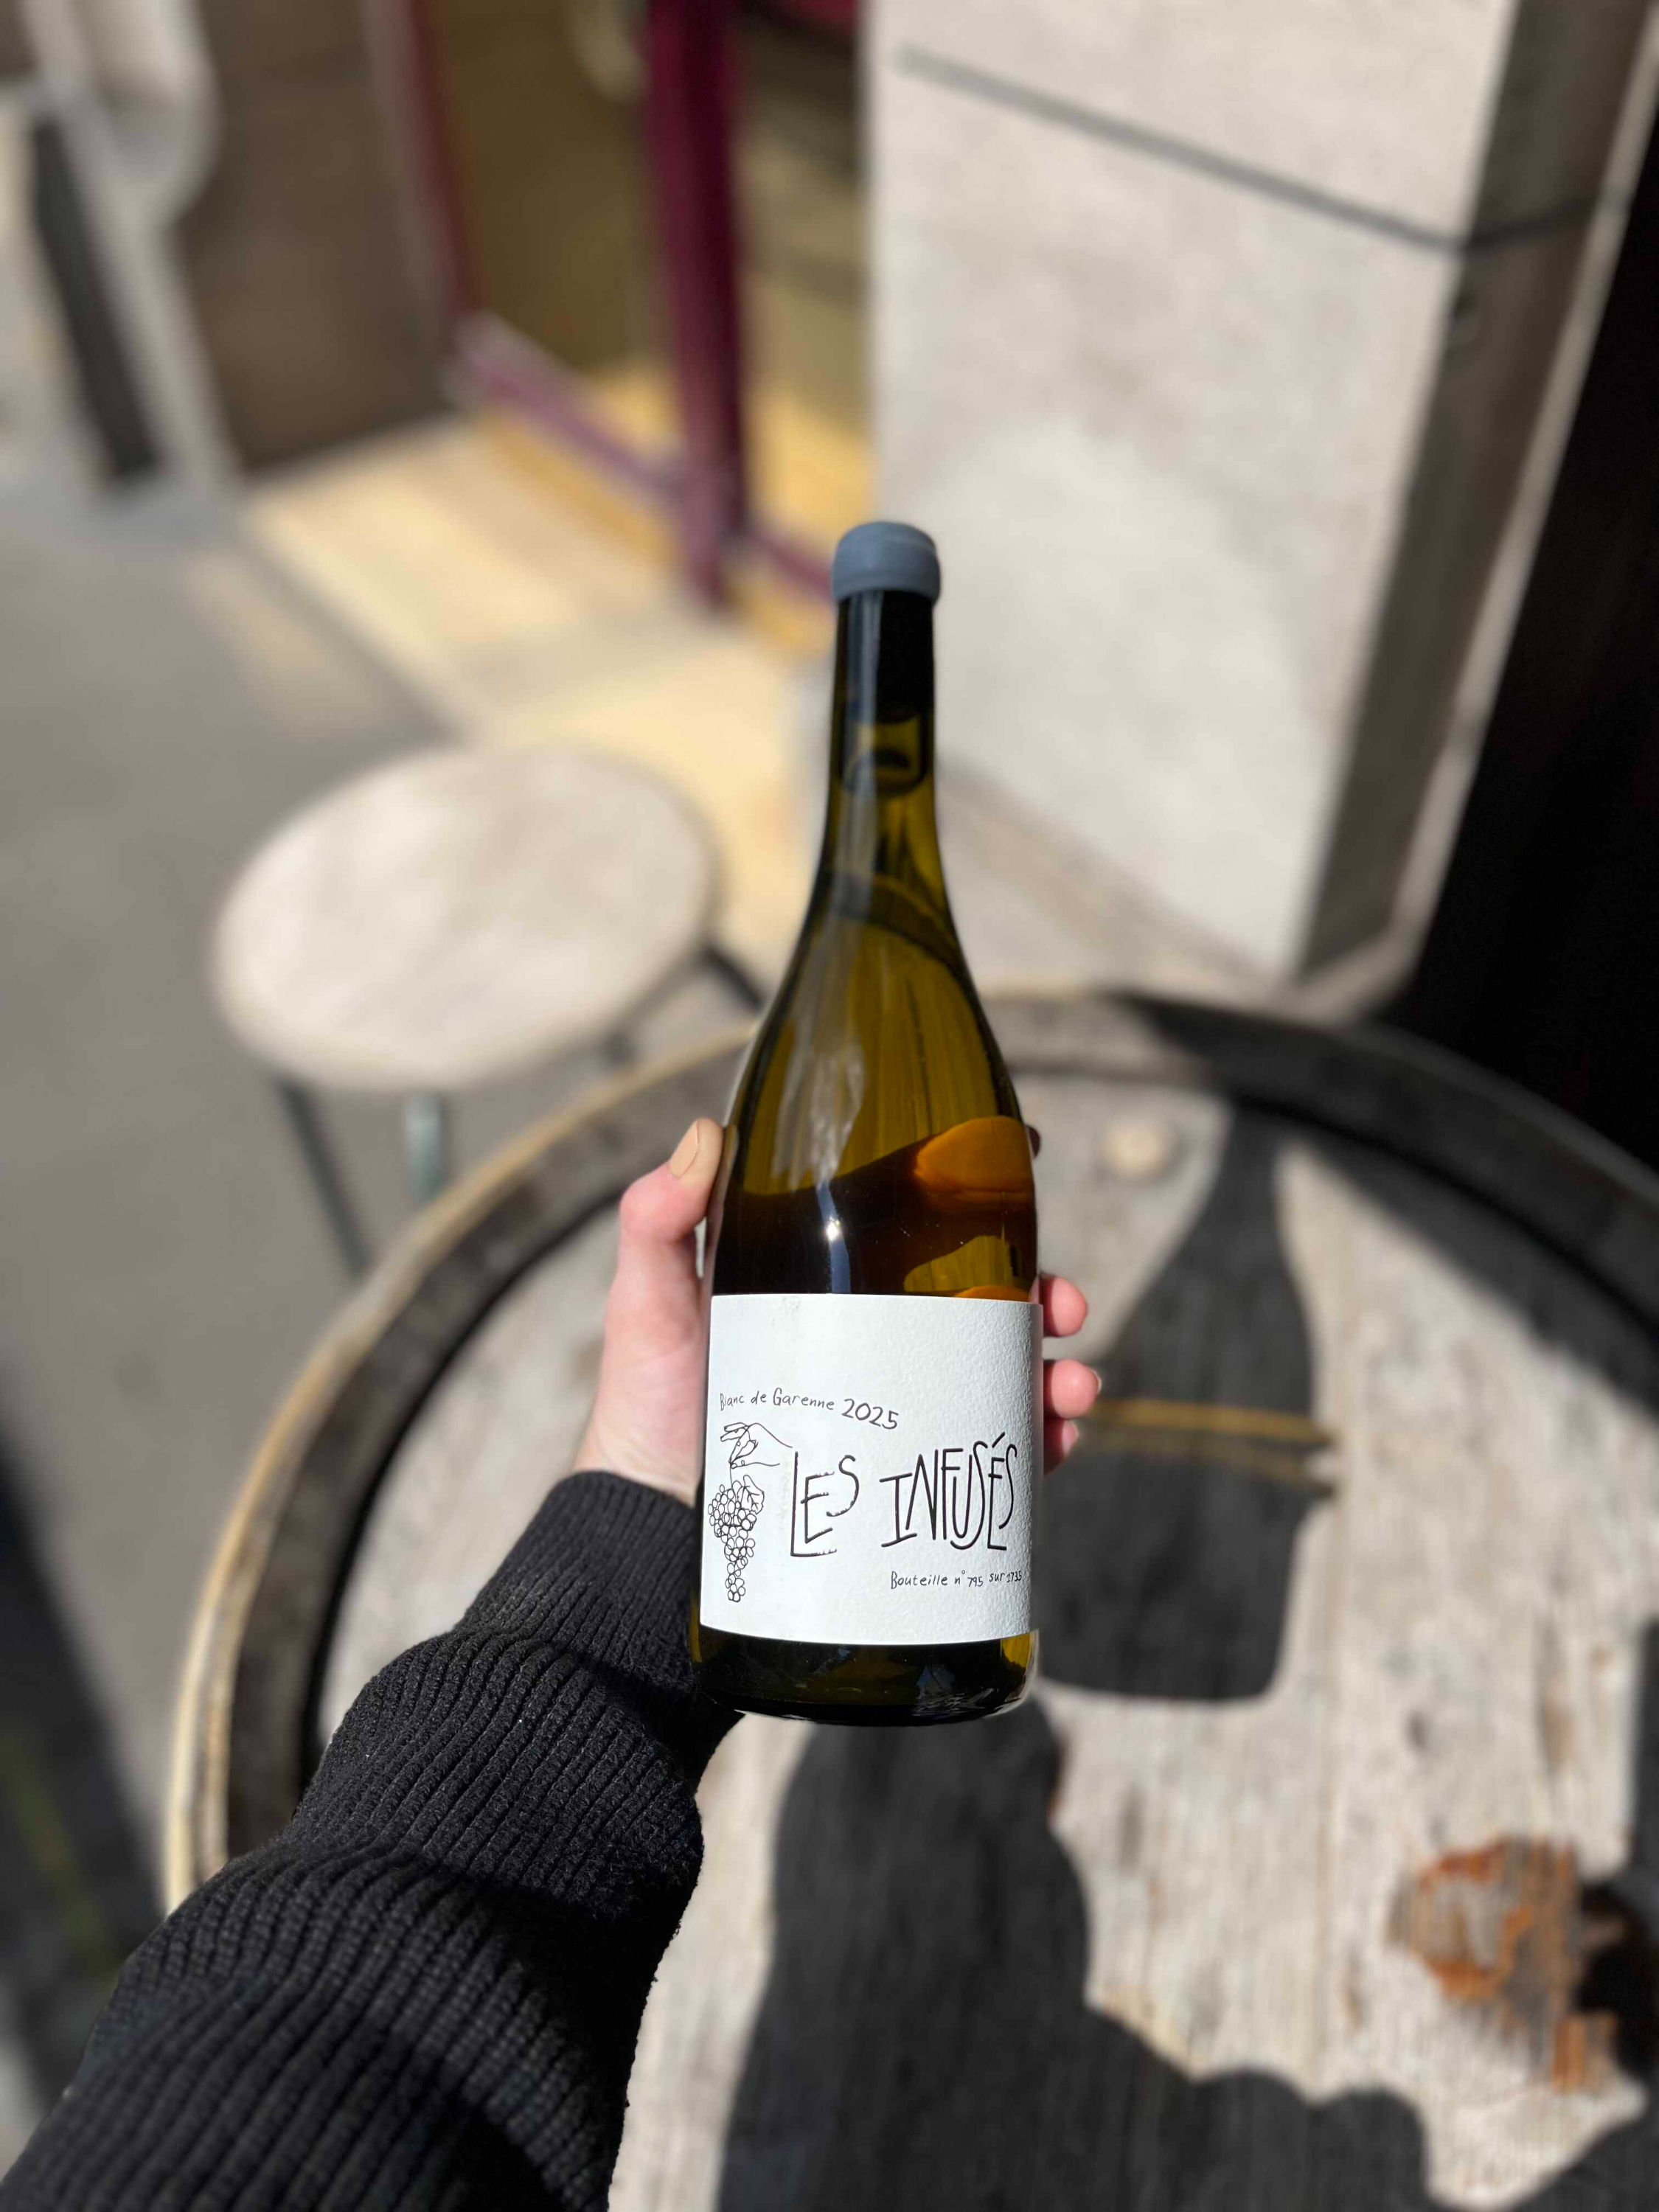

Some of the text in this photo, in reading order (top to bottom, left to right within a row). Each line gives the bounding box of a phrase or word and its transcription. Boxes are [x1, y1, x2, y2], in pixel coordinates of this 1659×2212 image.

[720, 1388, 899, 1429] Blanc de Garenne 2025
[790, 1431, 1018, 1557] LES INFUSÉS
[891, 1571, 948, 1589] Bouteille
[967, 1576, 984, 1587] 795
[989, 1572, 1005, 1582] sur
